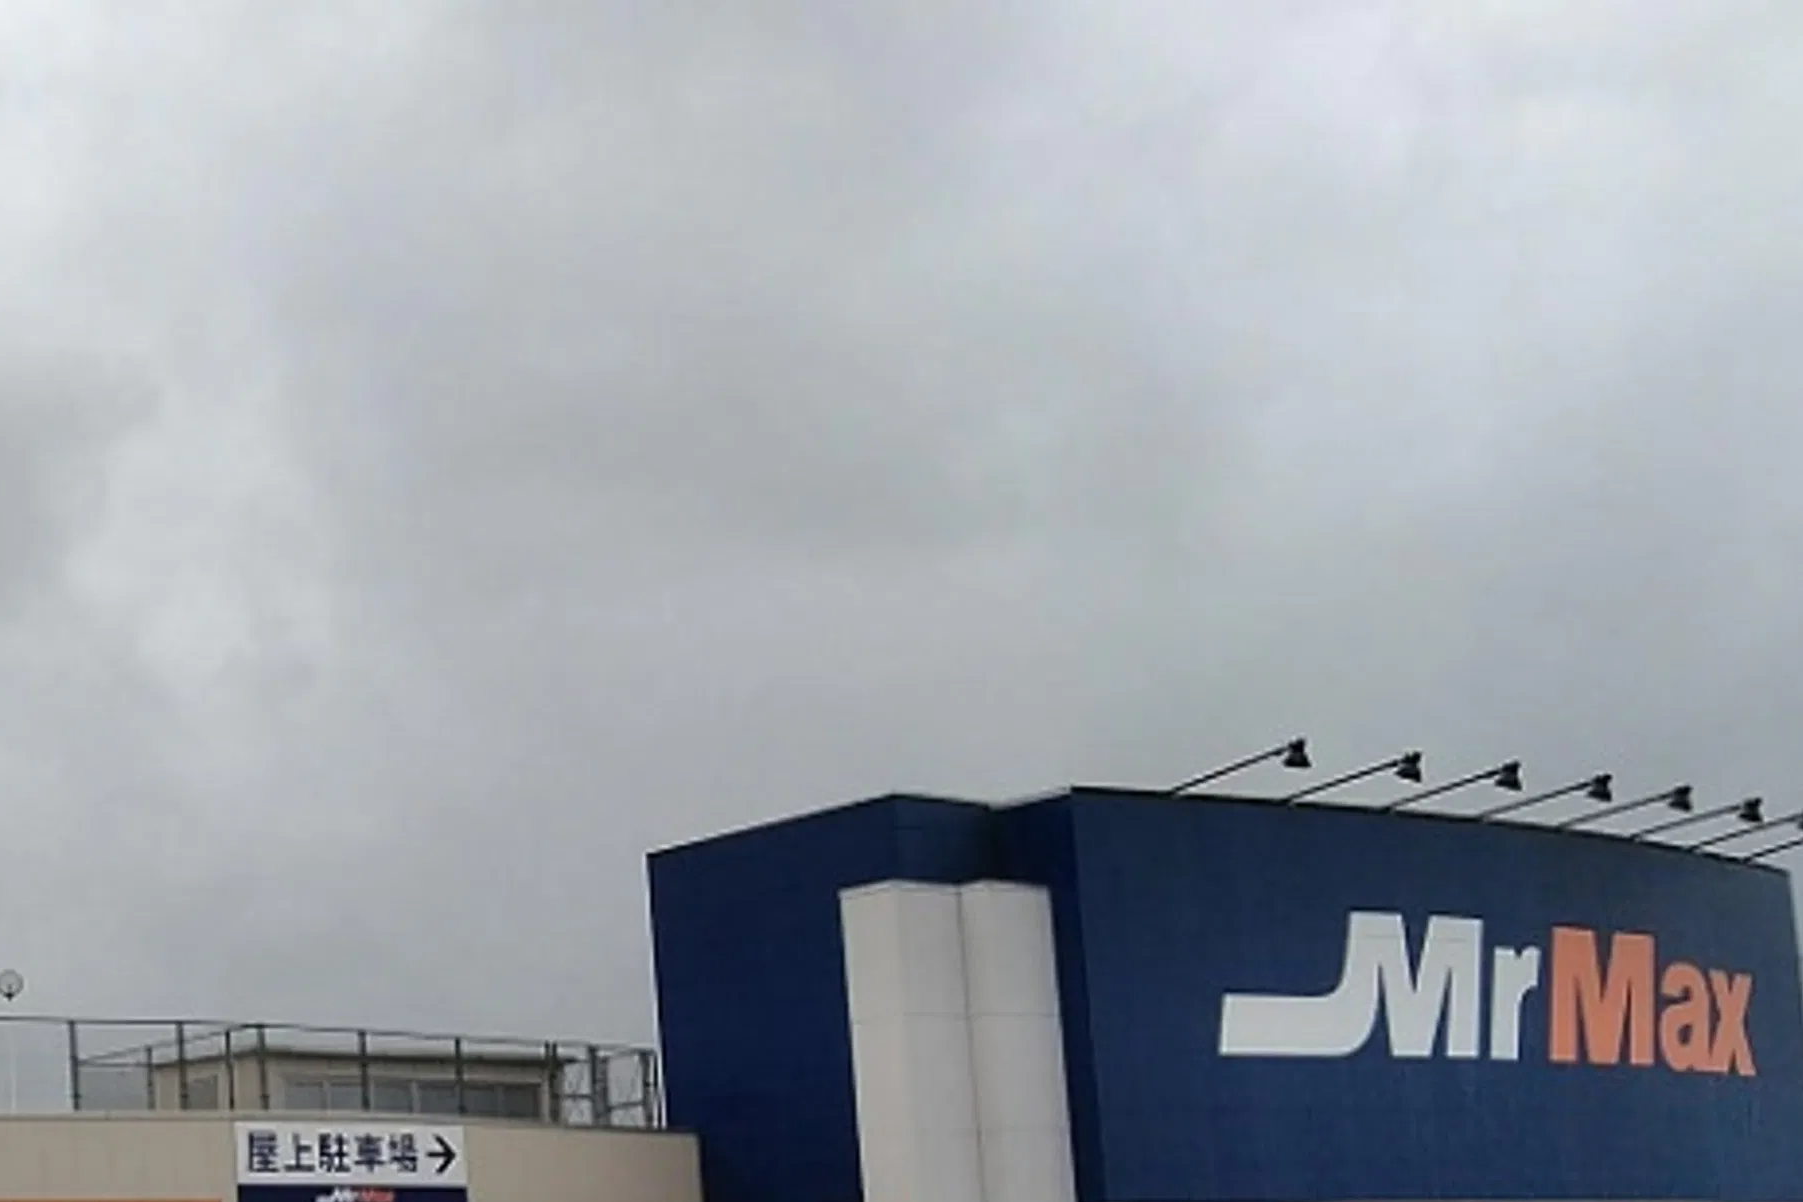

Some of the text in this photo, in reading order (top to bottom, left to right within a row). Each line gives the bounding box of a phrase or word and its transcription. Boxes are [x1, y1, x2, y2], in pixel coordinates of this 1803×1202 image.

[1219, 910, 1756, 1077] MrMax
[248, 1131, 418, 1174] 屋上駐車場
